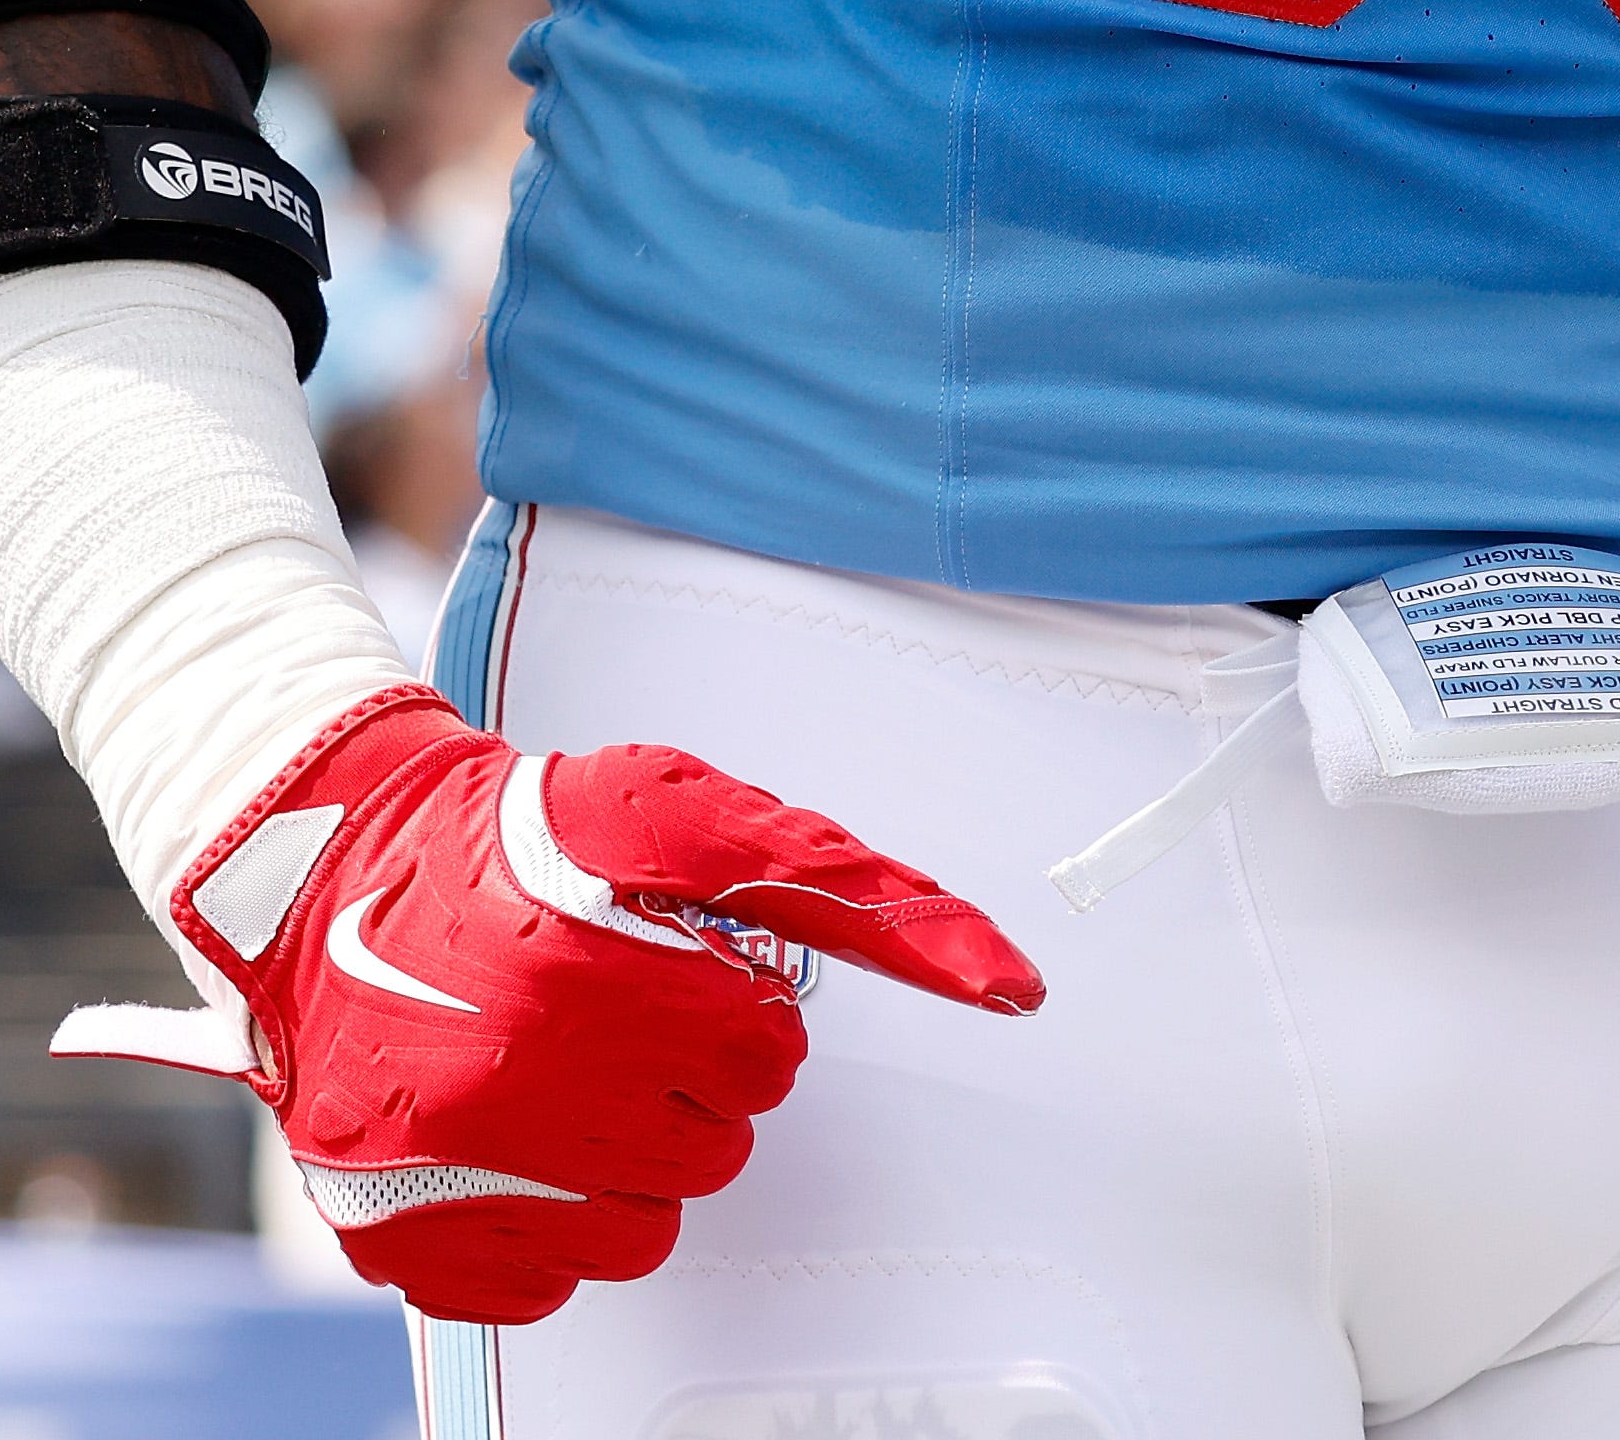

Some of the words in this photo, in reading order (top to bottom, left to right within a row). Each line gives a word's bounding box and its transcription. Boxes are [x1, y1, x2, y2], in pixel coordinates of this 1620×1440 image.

[200, 159, 315, 238] BREG
[1463, 549, 1573, 567] STRAIGHT
[1485, 571, 1593, 586] TORNADO
[1397, 577, 1478, 603] (POINT)
[1442, 597, 1503, 612] SNIPER
[1507, 593, 1573, 603] TEXICO,
[1578, 594, 1620, 603] BDRY
[1407, 607, 1438, 618] FLD
[1497, 613, 1552, 626] PICK
[1557, 613, 1603, 624] DBL
[1433, 617, 1492, 635] EASY
[1423, 636, 1519, 655] CHIPPERS
[1525, 634, 1584, 645] ALERT
[1434, 661, 1489, 673] WRAP
[1492, 658, 1526, 668] FLD
[1532, 655, 1608, 666] OUTLAW
[1441, 676, 1519, 695] (POINT)
[1524, 677, 1580, 690] EASY
[1491, 698, 1603, 713] STRAIGHT
[736, 933, 798, 981] FL
